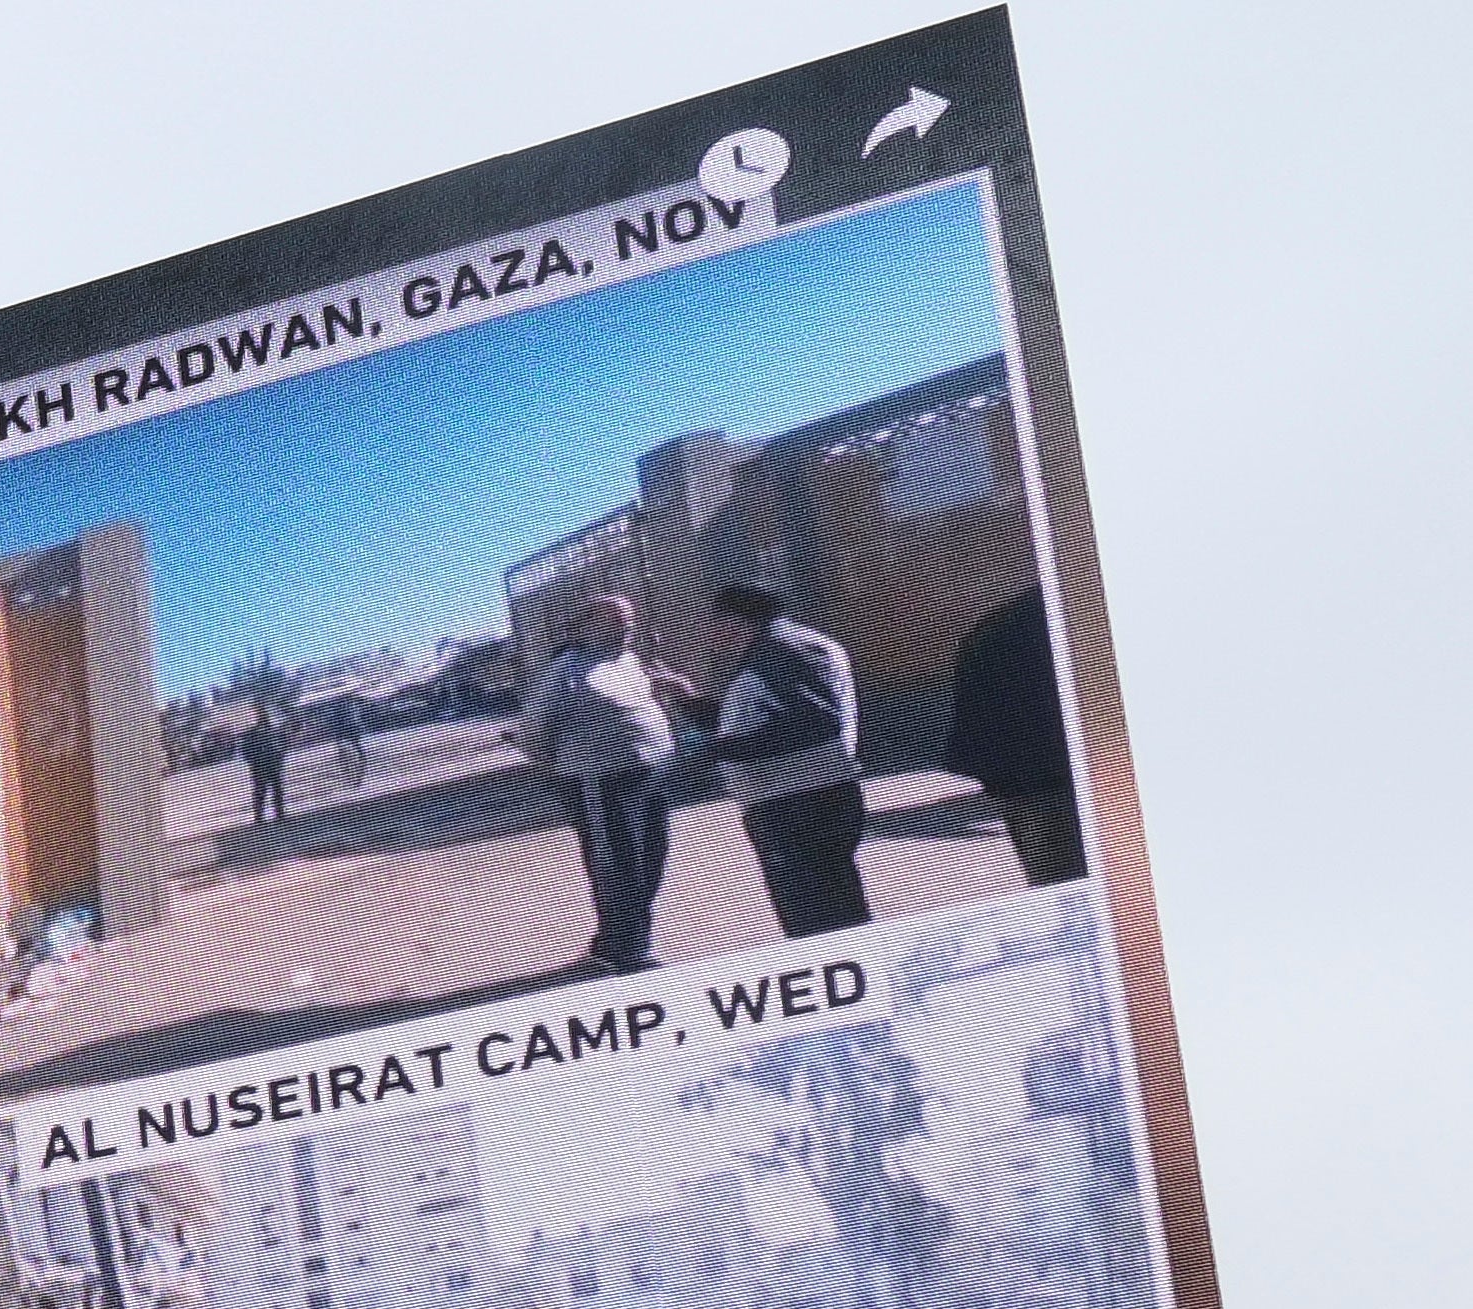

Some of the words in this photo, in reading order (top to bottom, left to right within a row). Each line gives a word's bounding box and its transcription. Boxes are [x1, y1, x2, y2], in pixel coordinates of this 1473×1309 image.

[94, 297, 382, 413] RADWAN,
[401, 239, 595, 321] GAZA,
[615, 196, 745, 261] NOV
[42, 1115, 118, 1170] AL
[139, 1044, 456, 1150] NUSEIRAT
[477, 1001, 688, 1078] CAMP,
[707, 961, 868, 1029] WED
